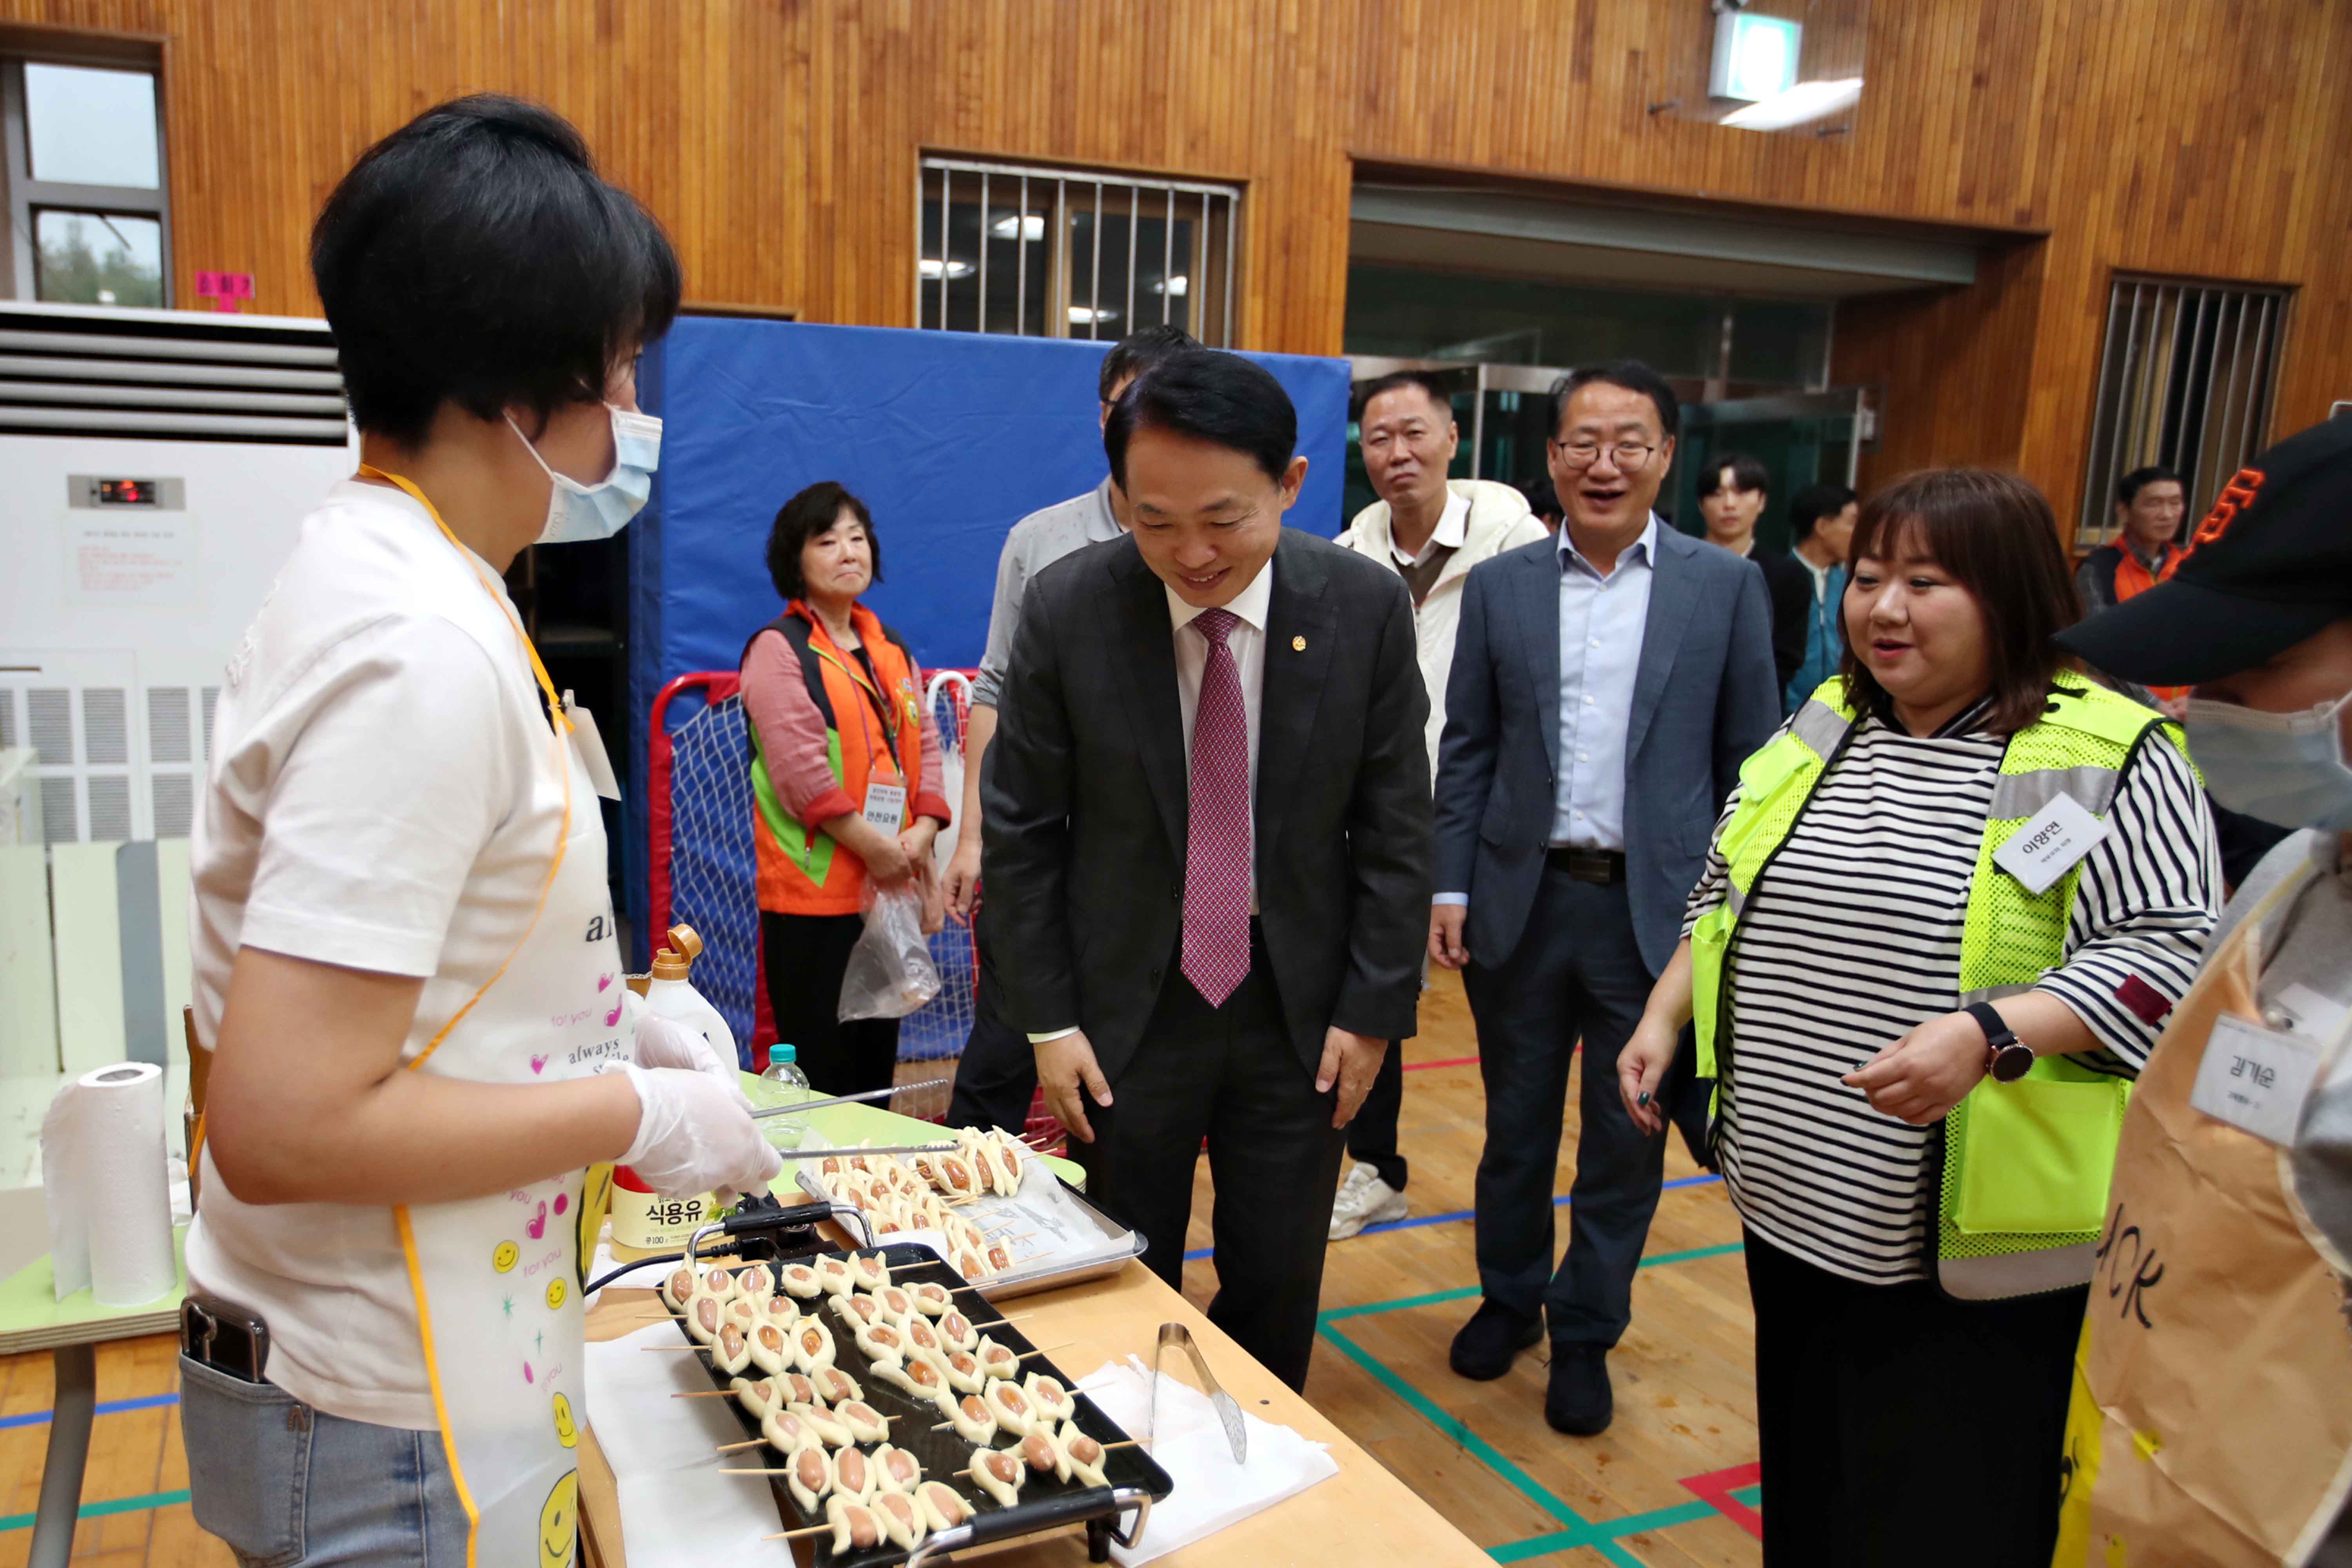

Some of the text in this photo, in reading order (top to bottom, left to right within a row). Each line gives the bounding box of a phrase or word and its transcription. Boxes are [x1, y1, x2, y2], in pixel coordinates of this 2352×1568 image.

[2022, 821, 2063, 854] 이양연
[571, 1007, 592, 1026] you
[568, 1038, 620, 1064] always
[2230, 1055, 2276, 1089] 김기순
[646, 1200, 702, 1225] 식용유
